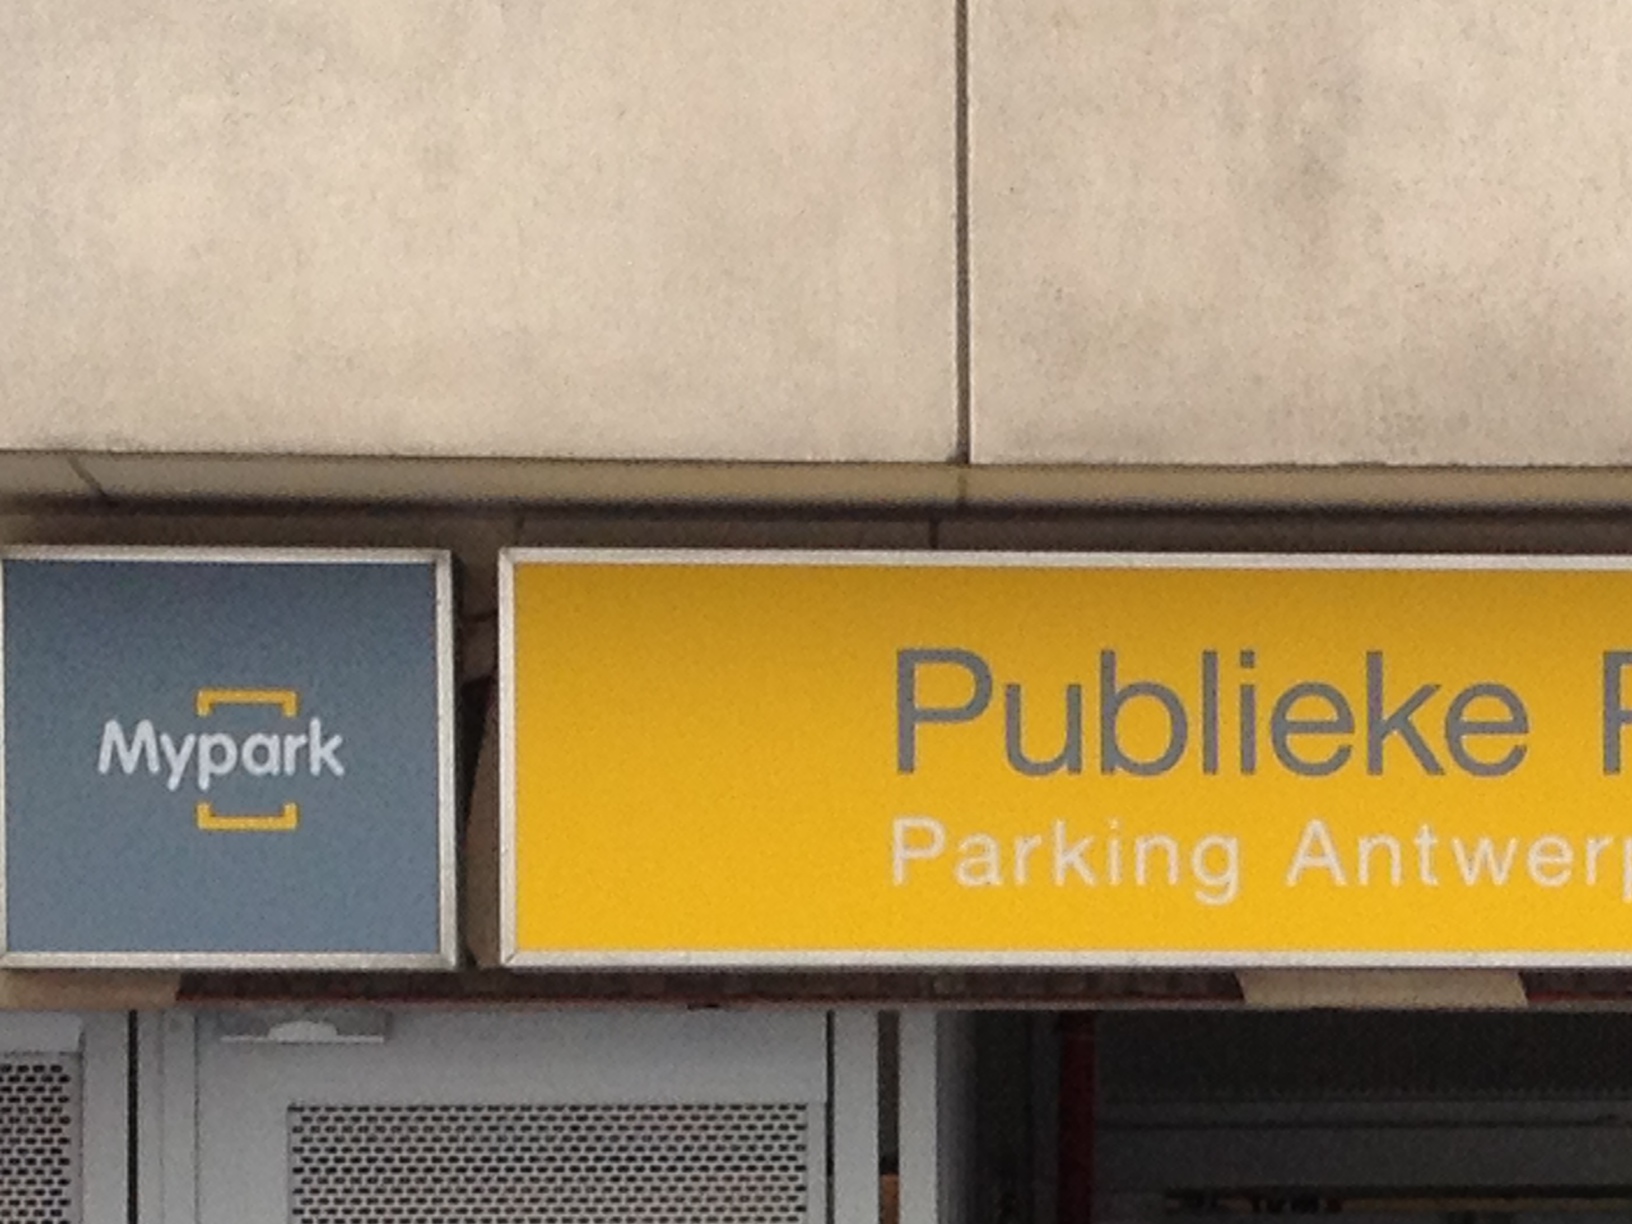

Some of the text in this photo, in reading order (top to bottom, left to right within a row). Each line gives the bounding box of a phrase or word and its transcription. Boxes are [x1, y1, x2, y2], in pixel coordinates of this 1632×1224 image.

[98, 716, 346, 791] Mypark
[895, 648, 1530, 777] Publieke
[891, 814, 1241, 906] Parking
